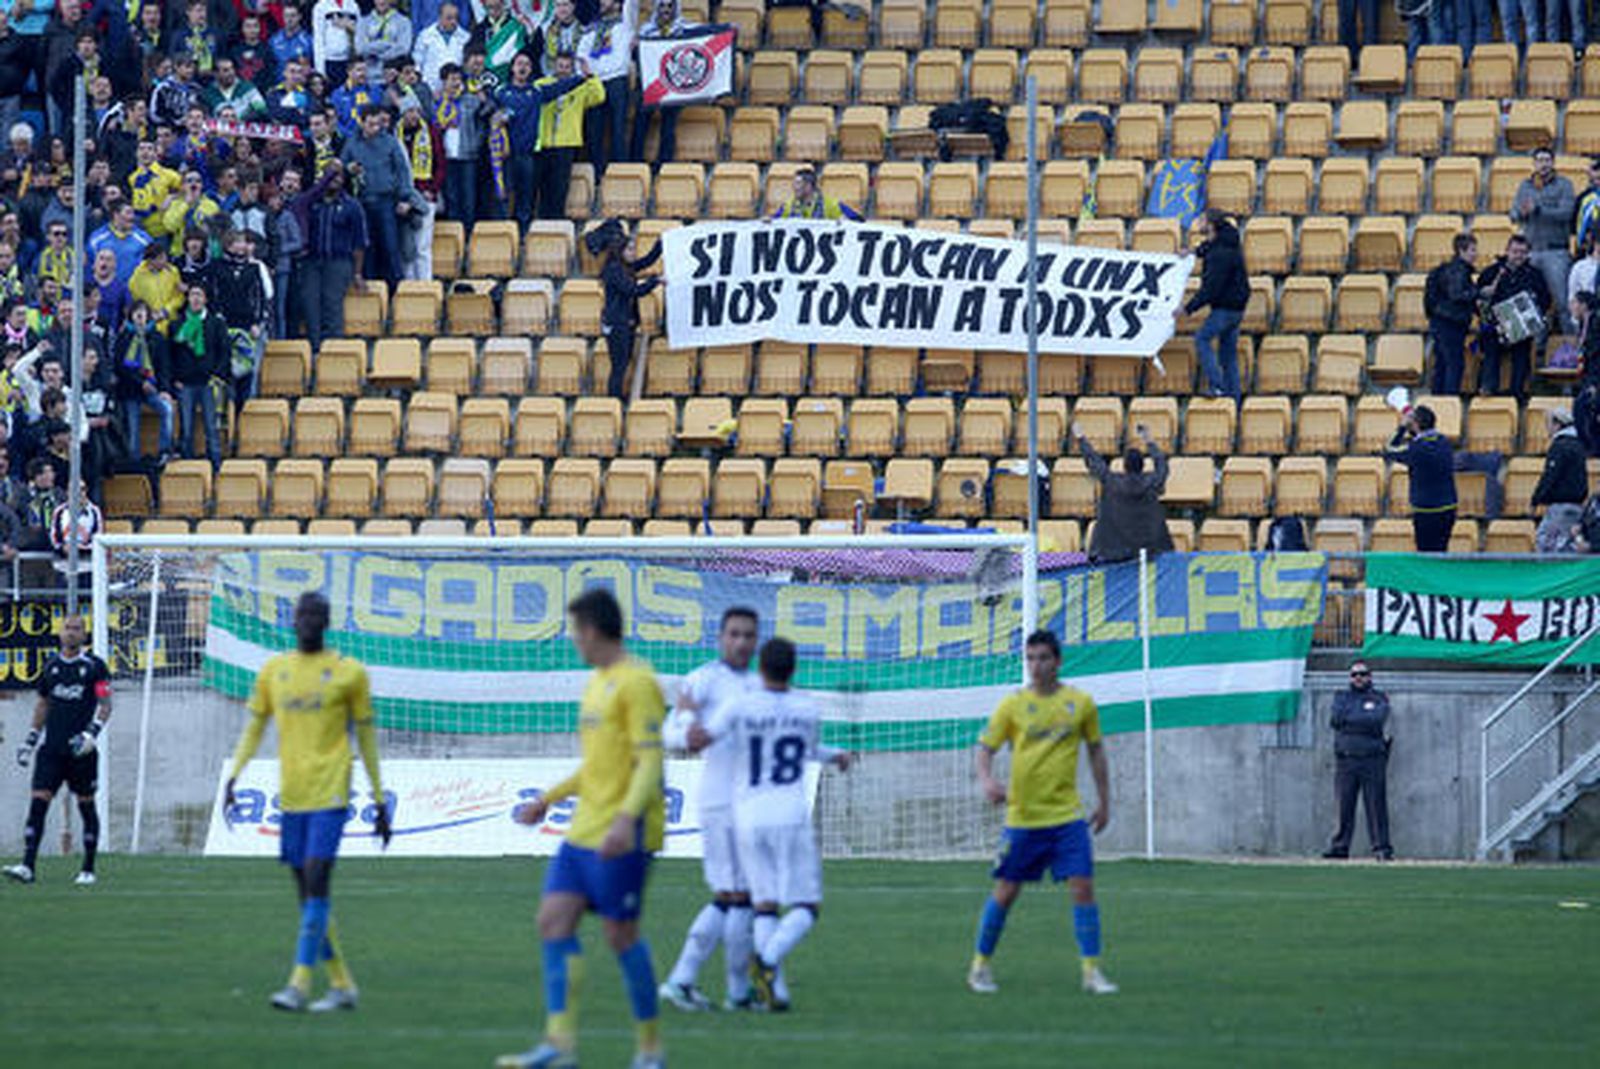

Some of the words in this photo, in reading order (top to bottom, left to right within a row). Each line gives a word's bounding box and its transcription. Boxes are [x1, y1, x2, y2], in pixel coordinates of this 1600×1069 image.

[690, 231, 737, 278] SI
[751, 228, 846, 275] NOS
[857, 231, 1012, 282] TOCAN
[1016, 253, 1057, 284] A
[692, 278, 784, 327] NOS
[797, 278, 943, 330] TOCAN
[953, 286, 987, 332] A
[999, 287, 1151, 340] TODXS
[776, 553, 1325, 658] AMARILLAS
[1376, 586, 1478, 643] PARK
[749, 734, 806, 787] 18
